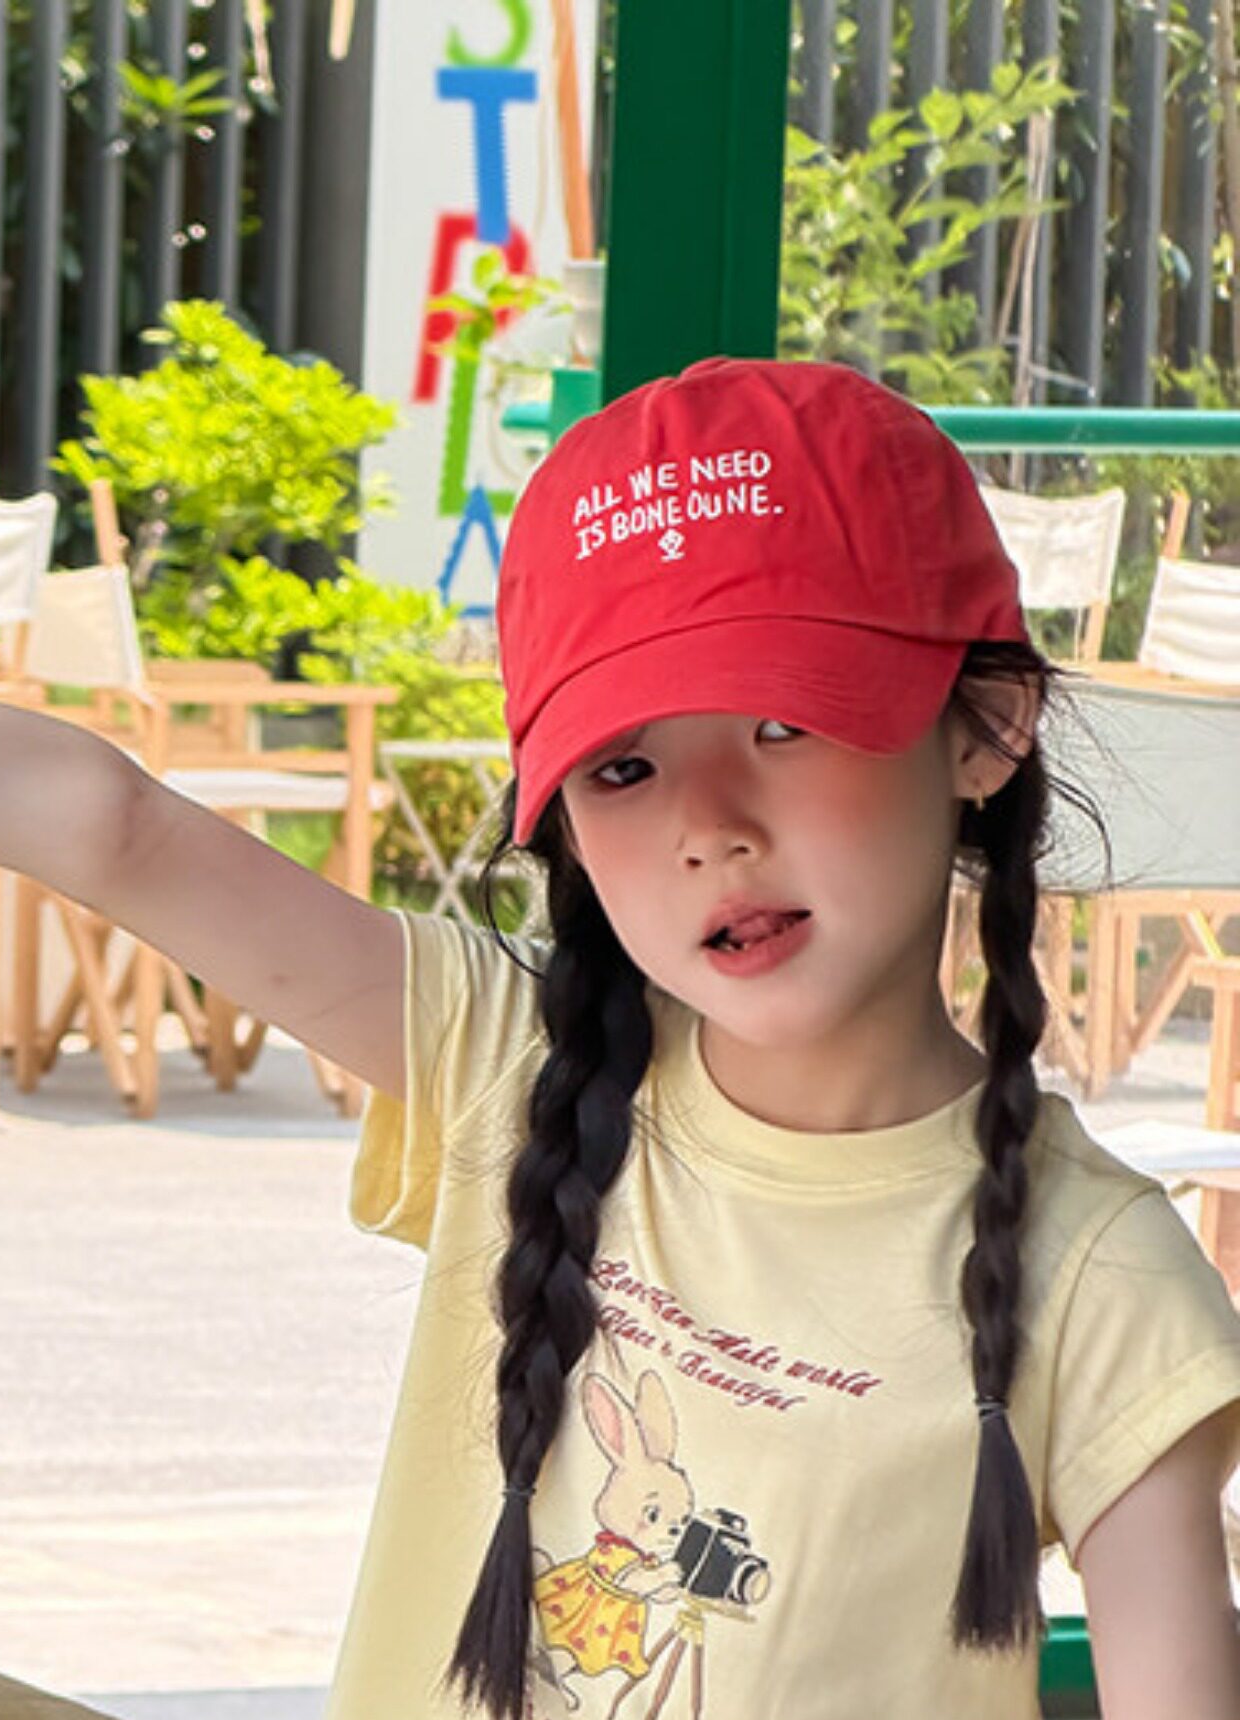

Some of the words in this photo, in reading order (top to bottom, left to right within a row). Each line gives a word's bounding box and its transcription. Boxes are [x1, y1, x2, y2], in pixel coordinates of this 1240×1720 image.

[573, 484, 623, 526] ALL
[628, 462, 680, 501] WE
[690, 449, 772, 484] NEED
[575, 520, 606, 560] IS
[675, 1350, 808, 1411] Beautiful
[691, 1329, 781, 1372] Make
[785, 1359, 882, 1397] world
